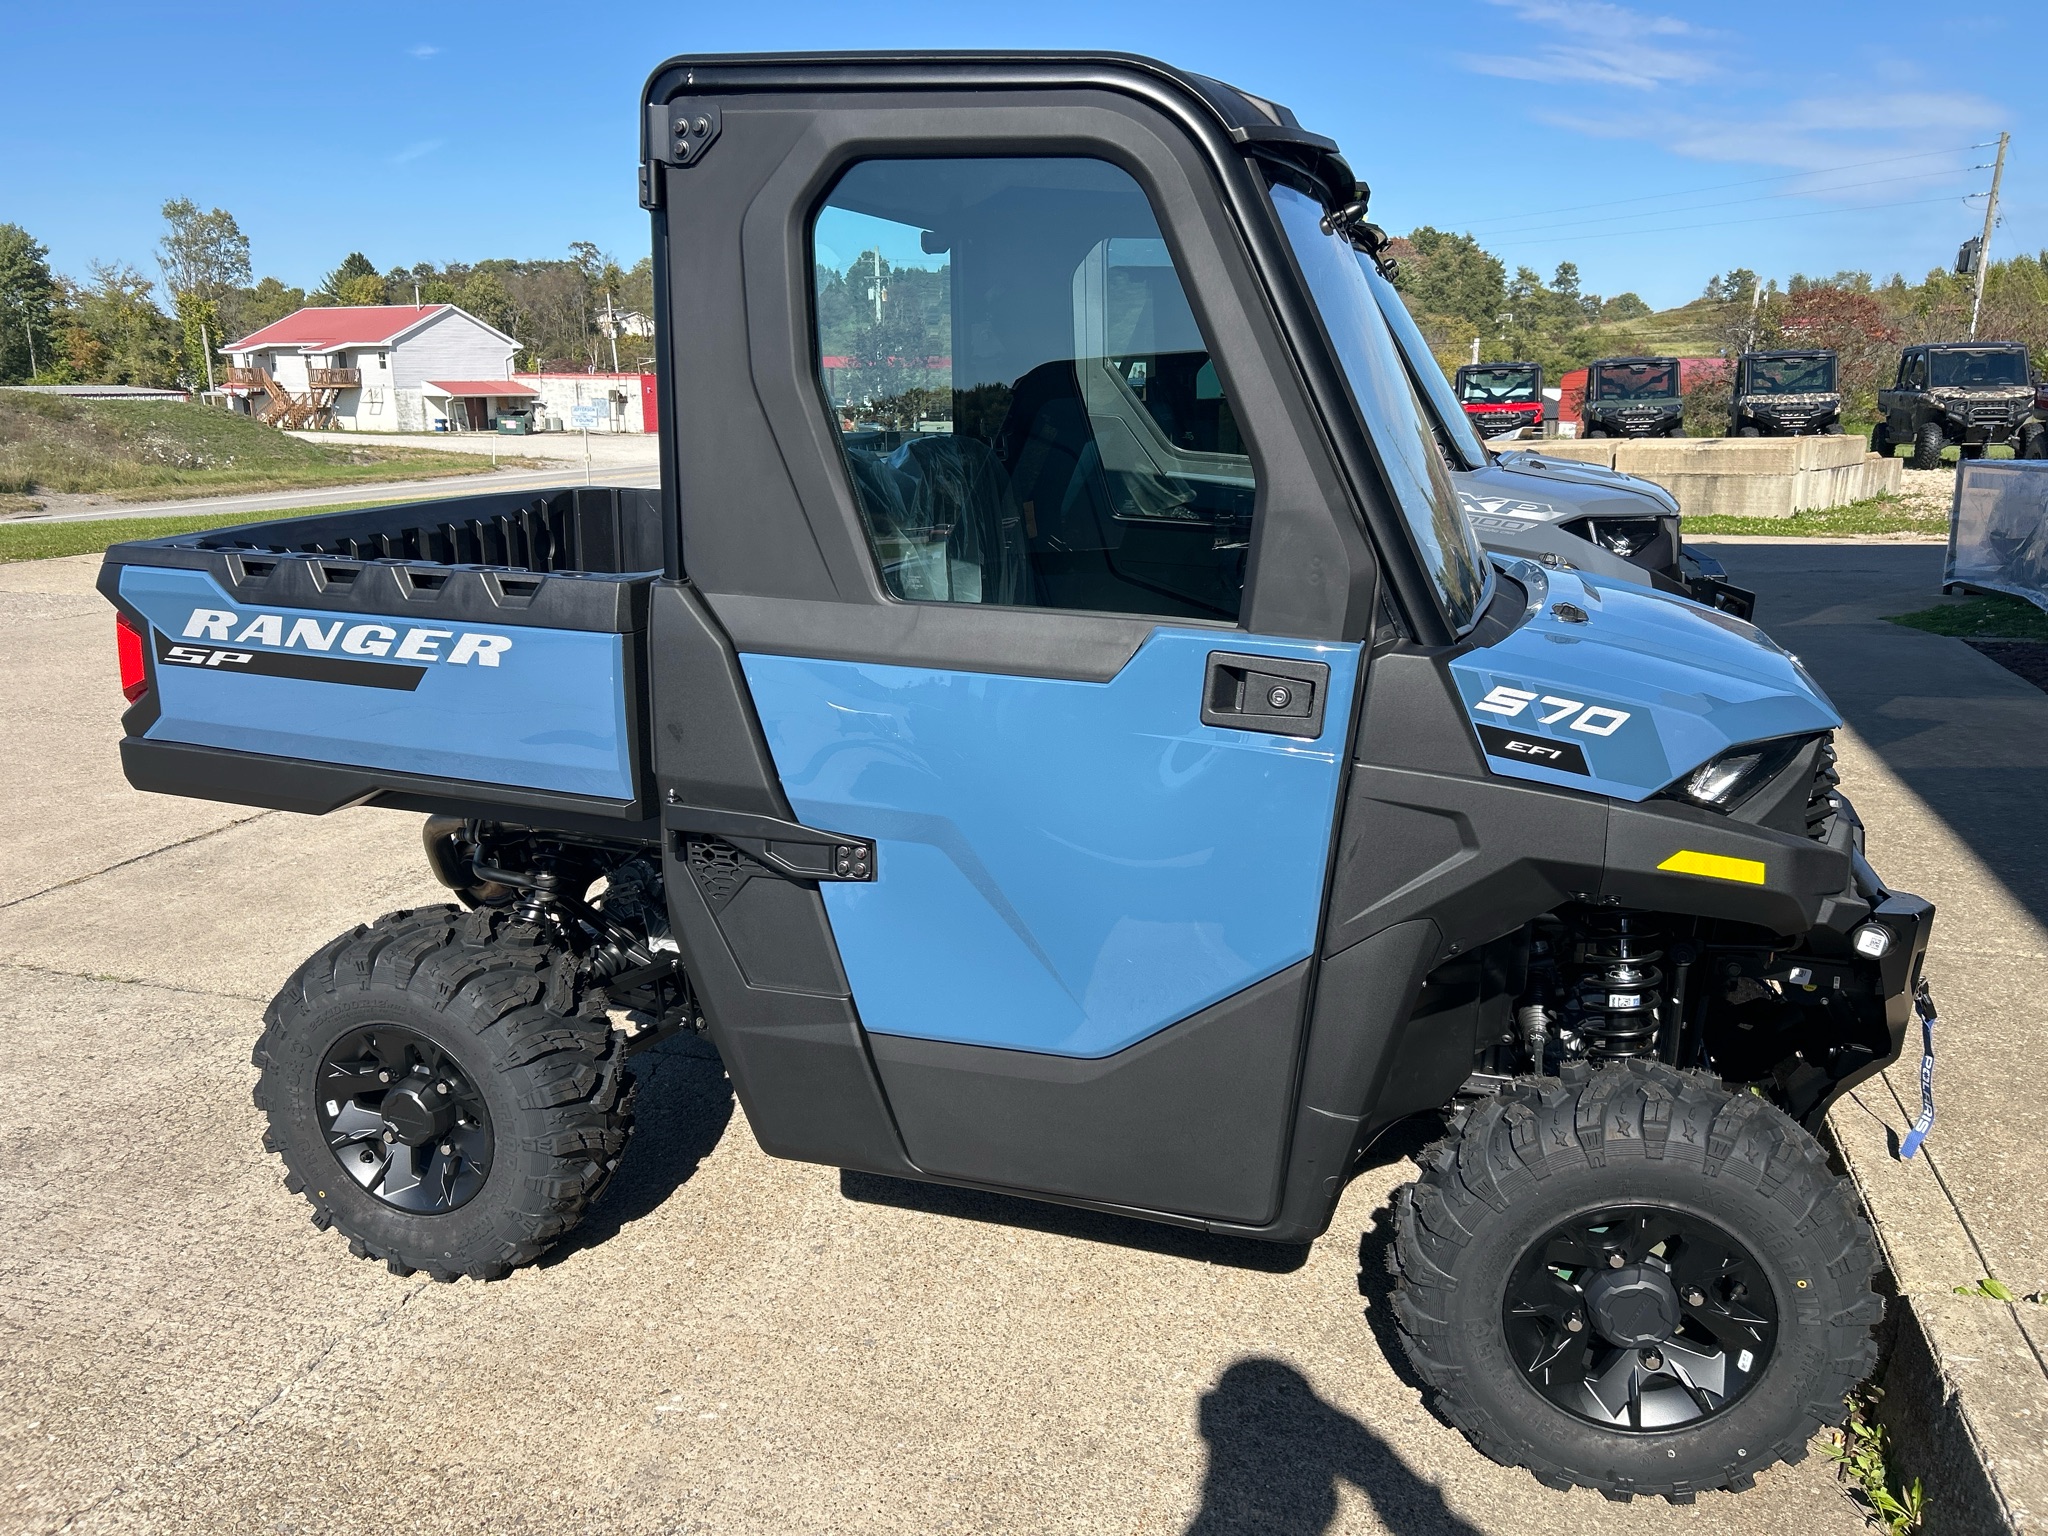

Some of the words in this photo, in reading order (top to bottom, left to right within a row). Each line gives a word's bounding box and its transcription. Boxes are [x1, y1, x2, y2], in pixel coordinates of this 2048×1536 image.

[163, 646, 253, 667] SP
[181, 608, 513, 668] RANGER
[1474, 685, 1631, 737] 570
[1504, 740, 1563, 760] EFI
[1915, 1055, 1933, 1134] POLARIS
